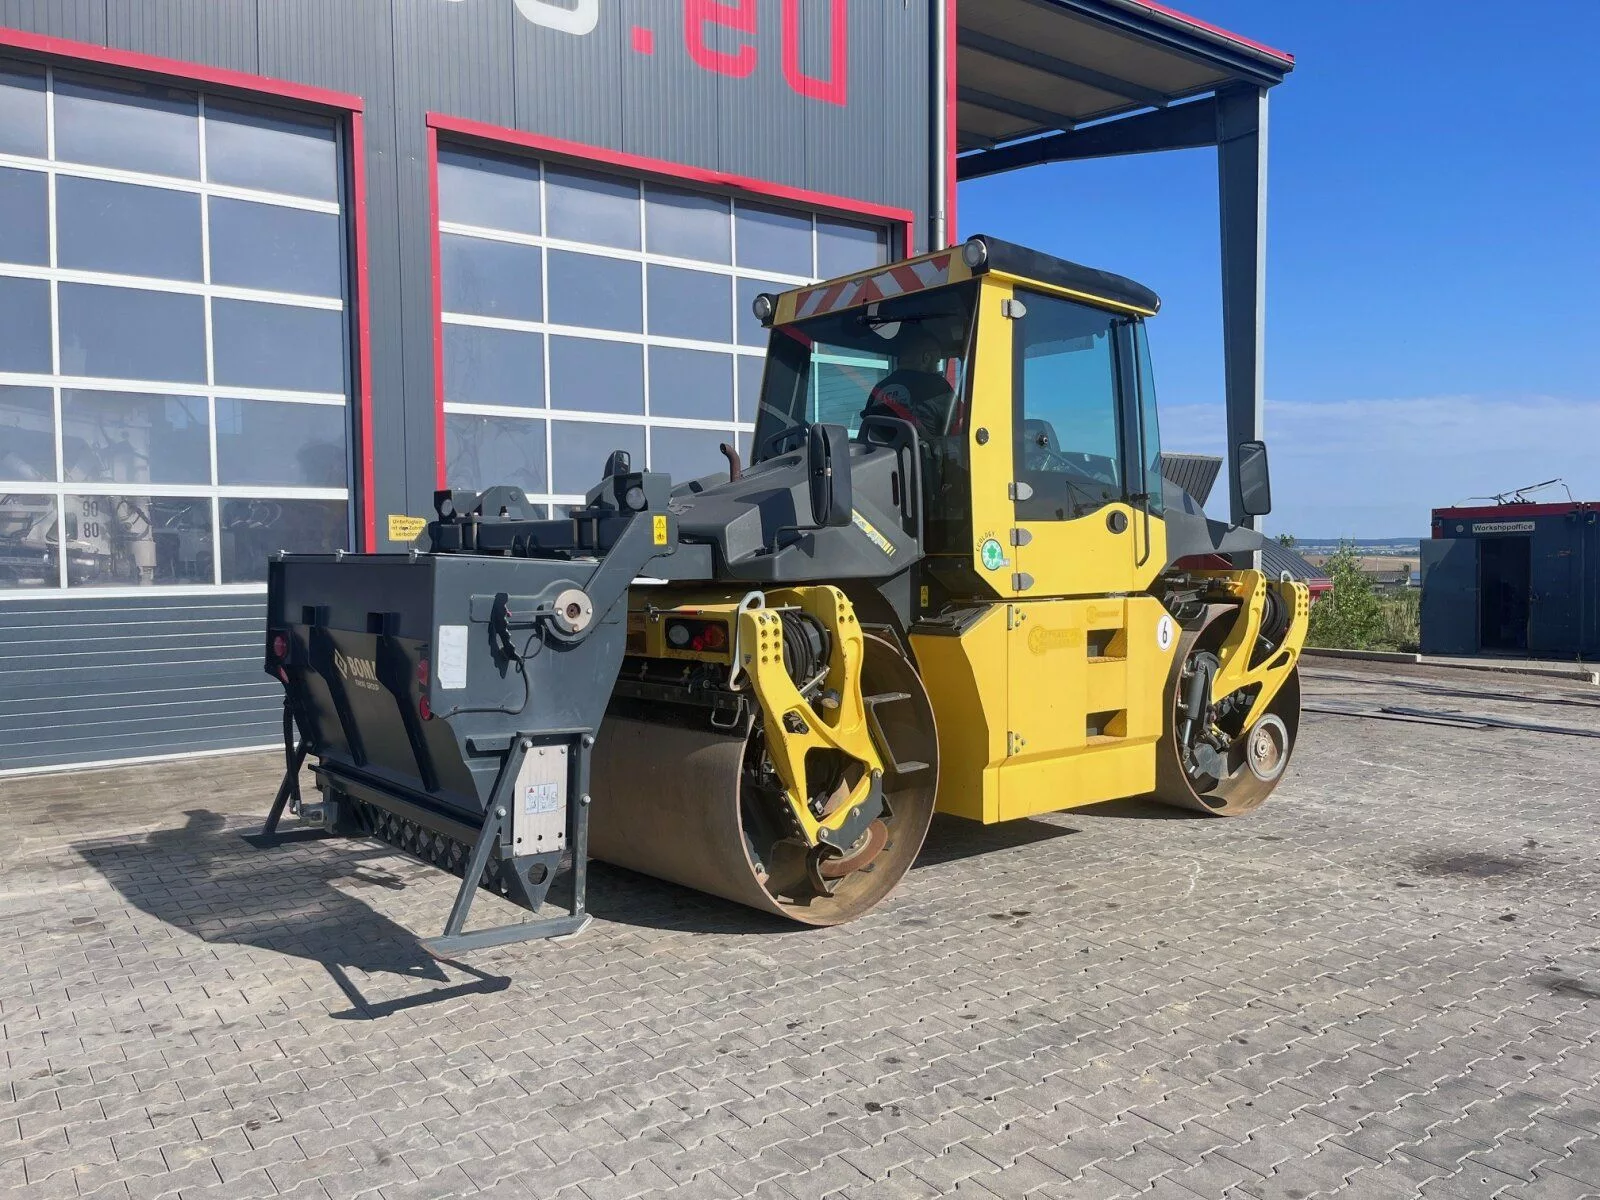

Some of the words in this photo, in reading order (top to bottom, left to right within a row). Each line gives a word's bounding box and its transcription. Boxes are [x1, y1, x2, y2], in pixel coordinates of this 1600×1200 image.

[82, 500, 99, 518] 90
[83, 521, 100, 538] 80
[1474, 523, 1533, 532] Workshopoffice
[1162, 620, 1168, 644] 6
[347, 655, 378, 681] BOM
